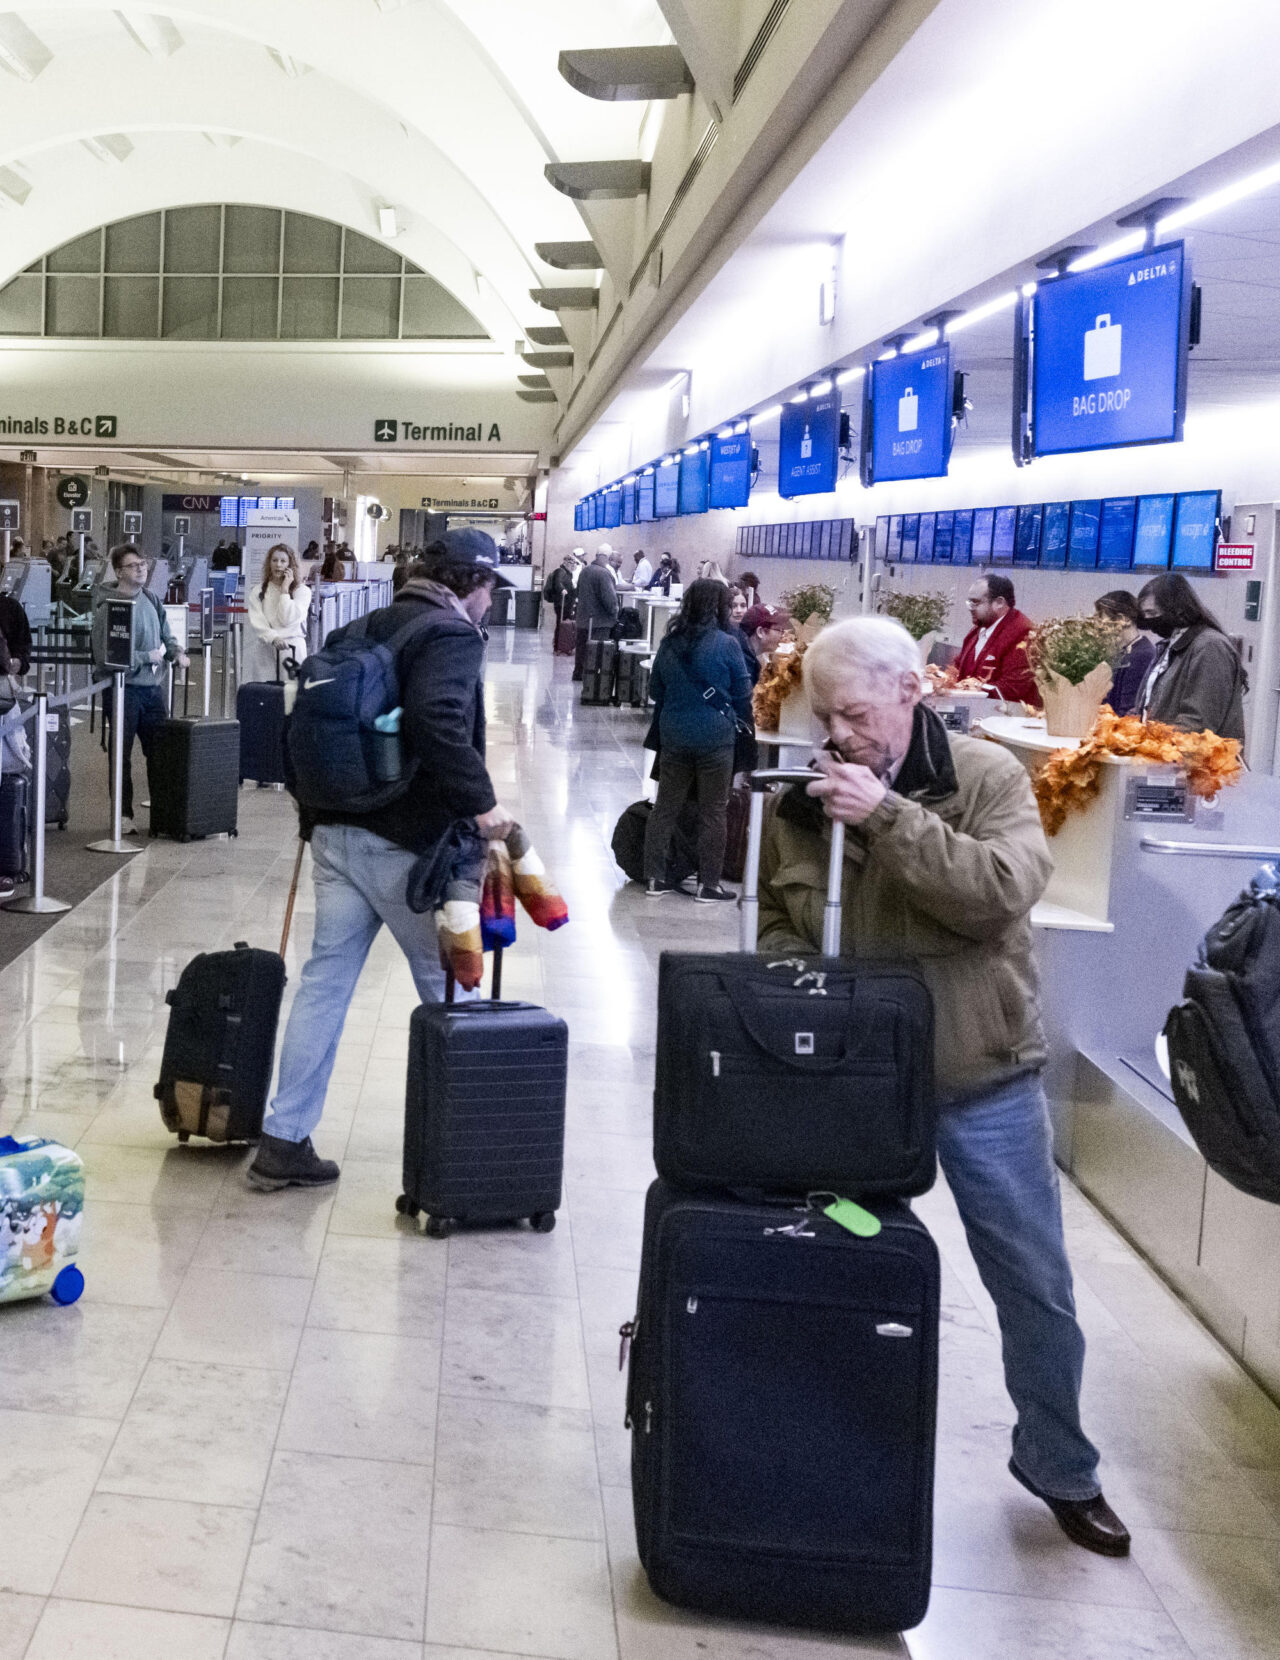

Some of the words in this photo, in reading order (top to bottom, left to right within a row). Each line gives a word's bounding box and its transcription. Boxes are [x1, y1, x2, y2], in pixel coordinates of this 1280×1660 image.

[1137, 263, 1168, 283] DELTA
[1072, 393, 1096, 416] BAG
[1097, 388, 1131, 414] DROP
[401, 422, 482, 442] Terminal
[487, 423, 501, 442] A
[892, 442, 905, 457] BAG
[905, 439, 923, 455] DROP
[182, 496, 210, 509] CNN
[432, 498, 469, 507] Terminals
[1218, 547, 1252, 556] BLEEDING
[1218, 558, 1251, 566] CONTROL
